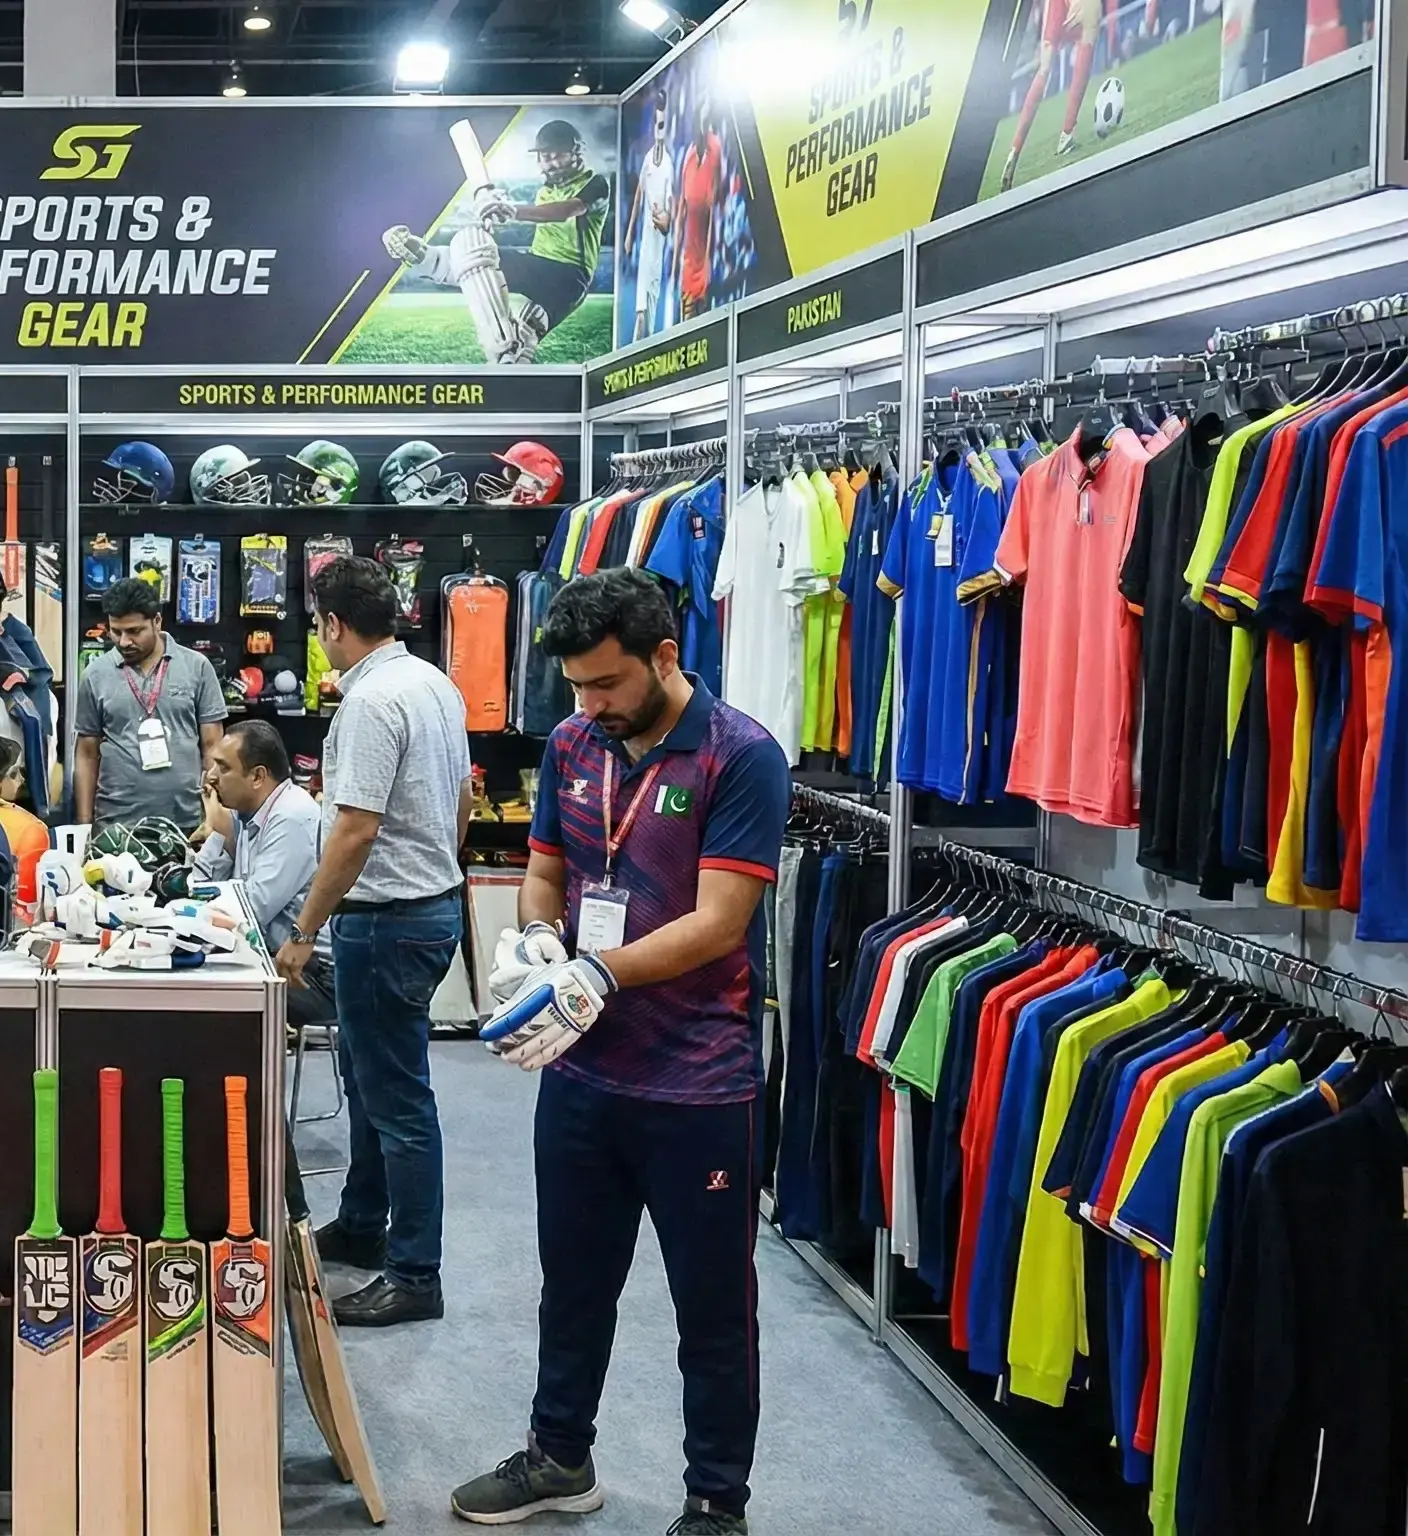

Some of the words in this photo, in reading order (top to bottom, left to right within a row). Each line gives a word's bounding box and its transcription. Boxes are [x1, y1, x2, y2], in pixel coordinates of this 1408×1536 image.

[785, 64, 936, 188] PERFORMANCE
[827, 152, 879, 217] GEAR
[175, 196, 212, 242] &
[17, 302, 149, 347] GEAR
[787, 289, 842, 334] PAKISTAN
[179, 384, 256, 405] SPORTS
[261, 384, 276, 405] &
[282, 384, 427, 405] PERFORMANCE
[432, 384, 484, 405] GEAR
